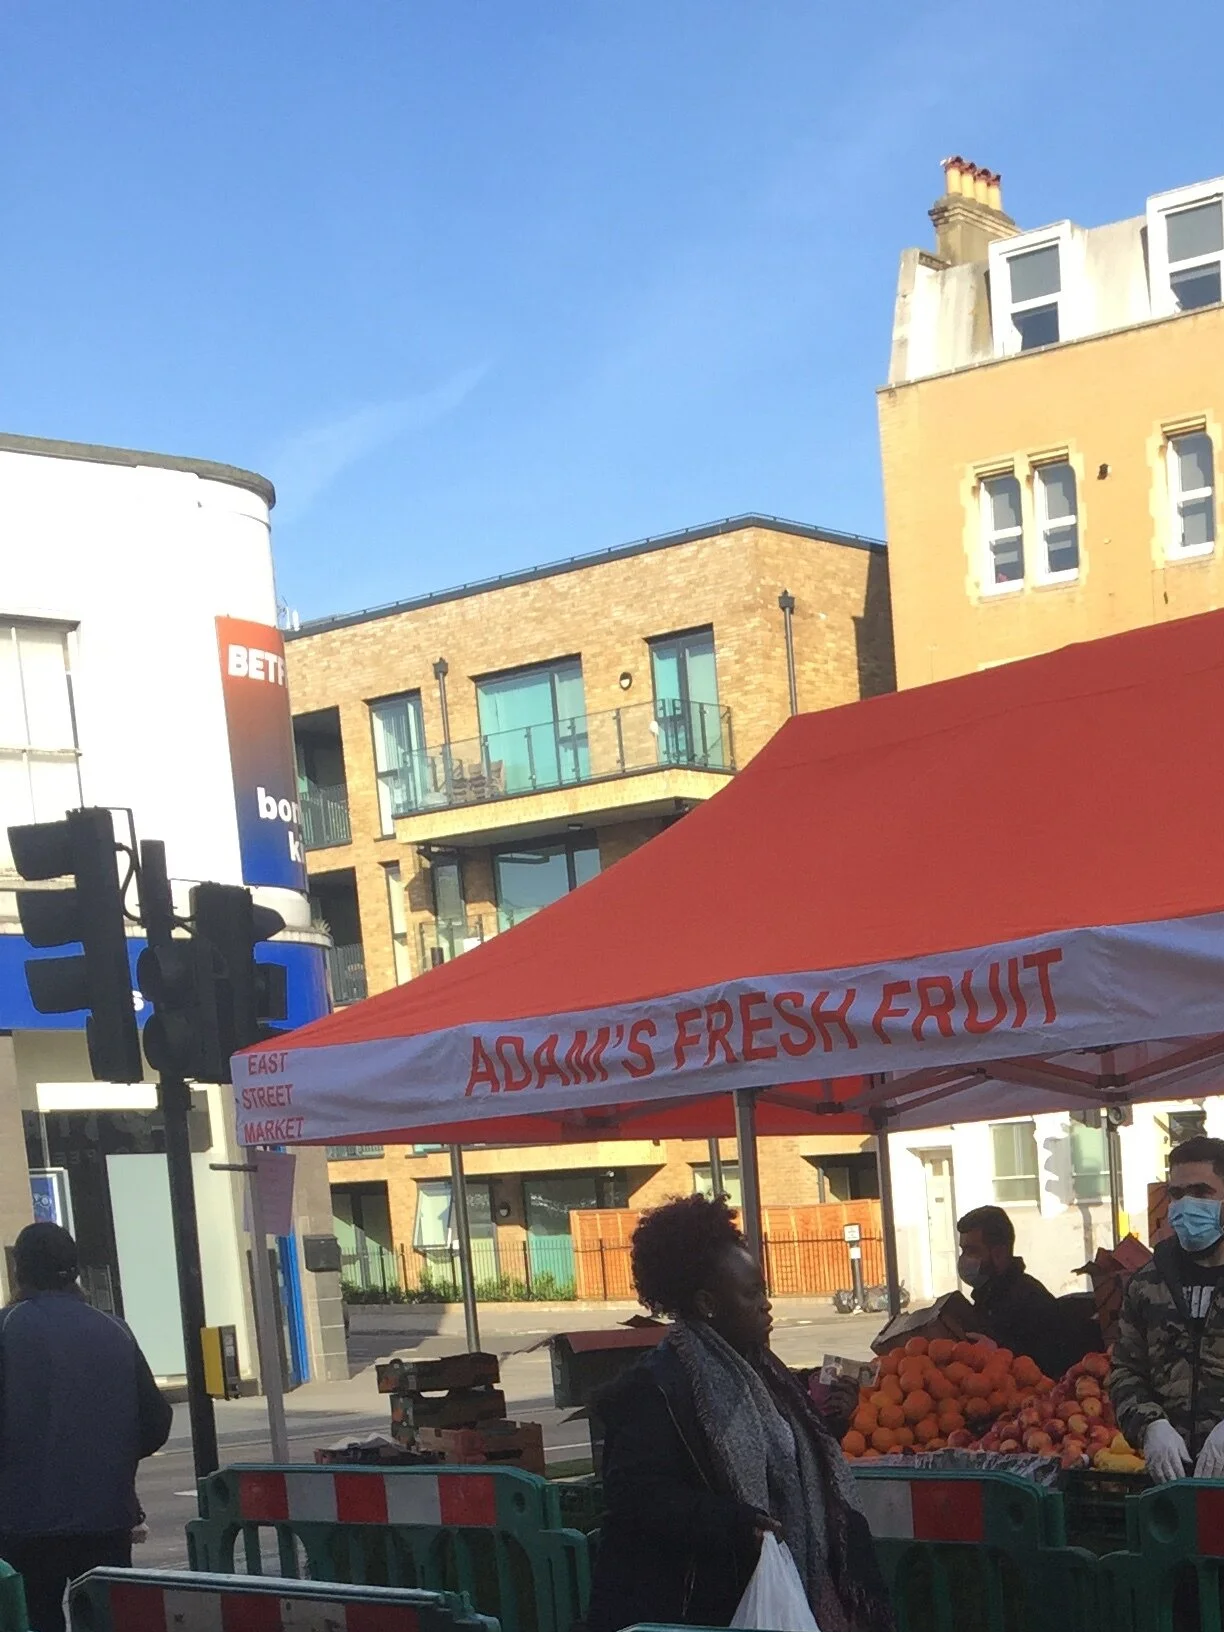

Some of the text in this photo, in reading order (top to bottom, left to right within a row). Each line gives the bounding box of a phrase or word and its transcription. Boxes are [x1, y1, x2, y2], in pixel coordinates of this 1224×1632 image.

[466, 949, 1064, 1097] ADAM'S FRESH FRUIT
[248, 1052, 288, 1076] EAST
[242, 1084, 293, 1109] STREET
[243, 1116, 304, 1143] MARKET
